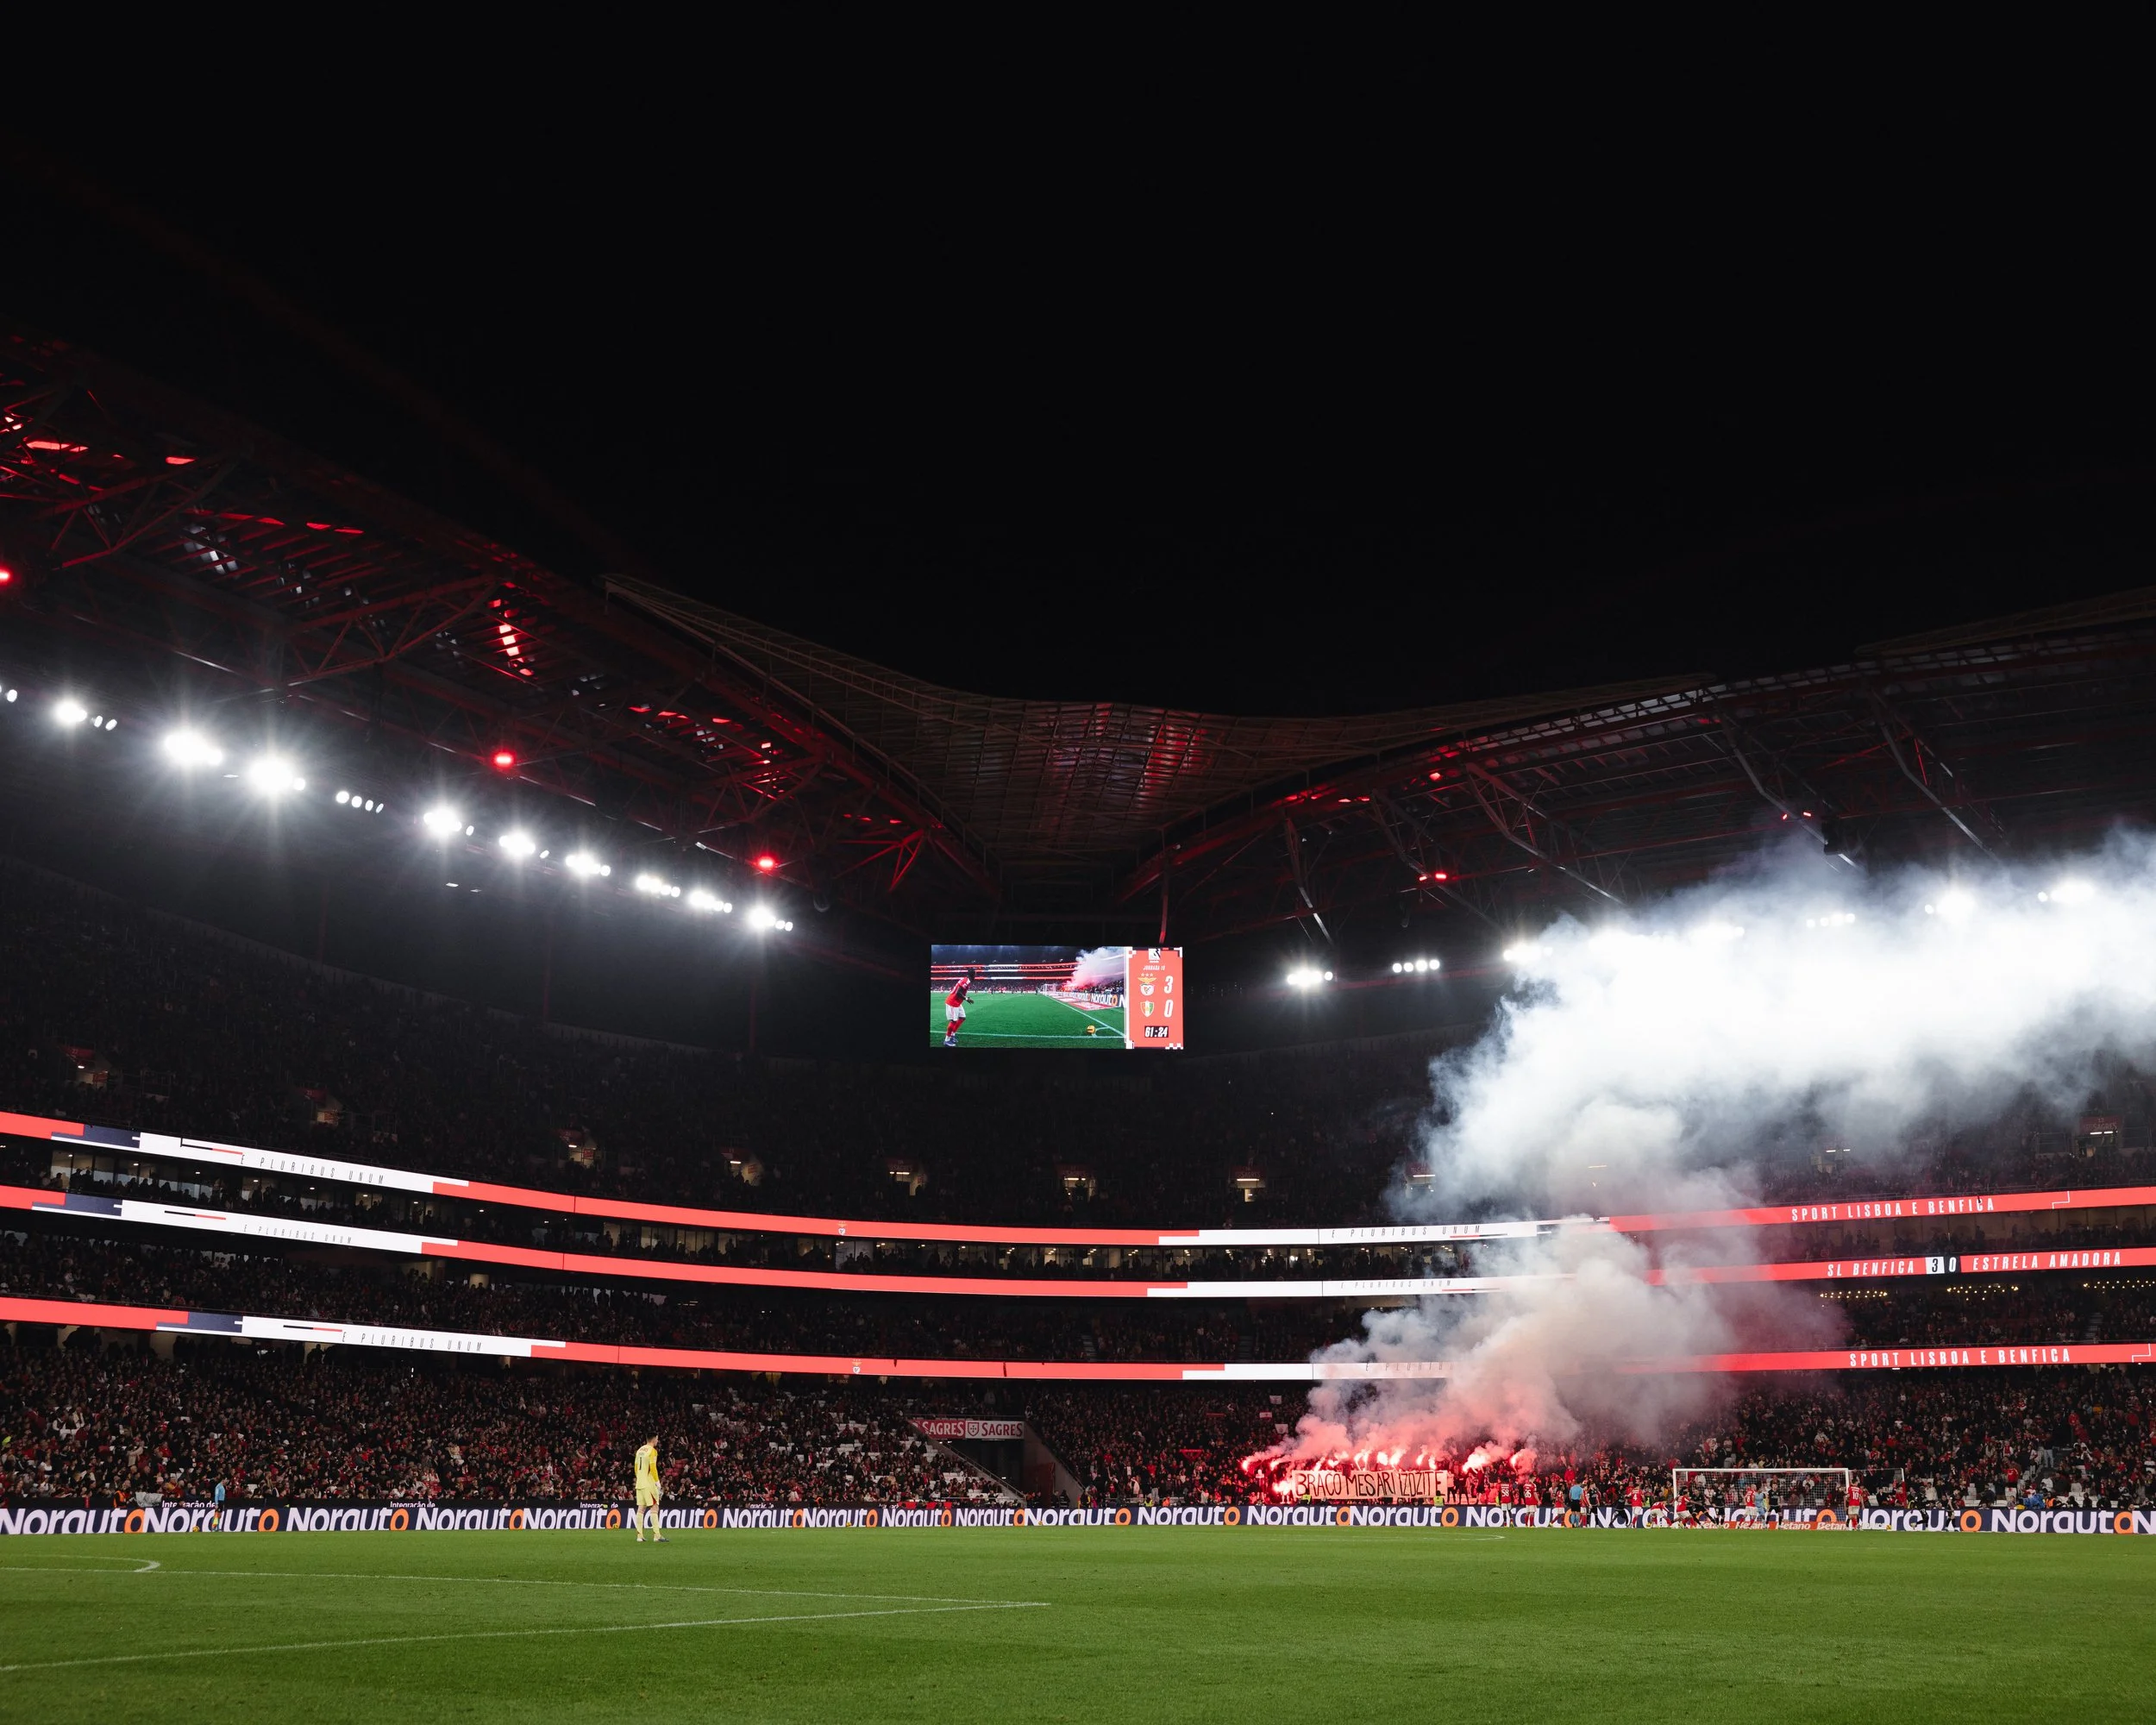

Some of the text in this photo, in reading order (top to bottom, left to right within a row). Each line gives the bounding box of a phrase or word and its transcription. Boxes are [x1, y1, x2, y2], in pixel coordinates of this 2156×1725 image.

[1163, 975, 1174, 994] 3
[1163, 999, 1174, 1018] 0
[1144, 1026, 1168, 1038] 61:24
[241, 1154, 384, 1184] E PLURIBUS UNUM
[1791, 1197, 1995, 1221] SPORT LISBOA E BENFICA
[258, 1226, 315, 1240] PLURIBUS
[324, 1235, 352, 1245] UNUM
[1332, 1225, 1480, 1238] E PLURIBUS UNUM
[1827, 1251, 2122, 1276] SL BENFICA 3 0 ESTRELA AMADORA
[1423, 1279, 1451, 1288] UNUM
[342, 1331, 482, 1352] E PLURIBUS UNUM
[1849, 1348, 2071, 1367] SPORT LISBOA E BENFICA
[922, 1421, 1023, 1437] SAGRES SAGRES
[1852, 1491, 1859, 1500] 10
[0, 1508, 144, 1534] Norauto
[285, 1507, 410, 1531] Norauto
[416, 1508, 524, 1531] Norauto
[522, 1508, 622, 1530] Norauto
[723, 1508, 805, 1529] Norauto
[803, 1509, 878, 1528] Norauto
[881, 1508, 952, 1527] Norauto
[955, 1508, 1025, 1527] Norauto
[1025, 1507, 1131, 1527] Norauto
[1138, 1506, 1241, 1526] Norauto
[1246, 1505, 1351, 1527] Norauto
[1350, 1506, 1459, 1527] Norauto
[1991, 1509, 2133, 1534] Norauto
[1816, 1521, 1847, 1530] Betan
